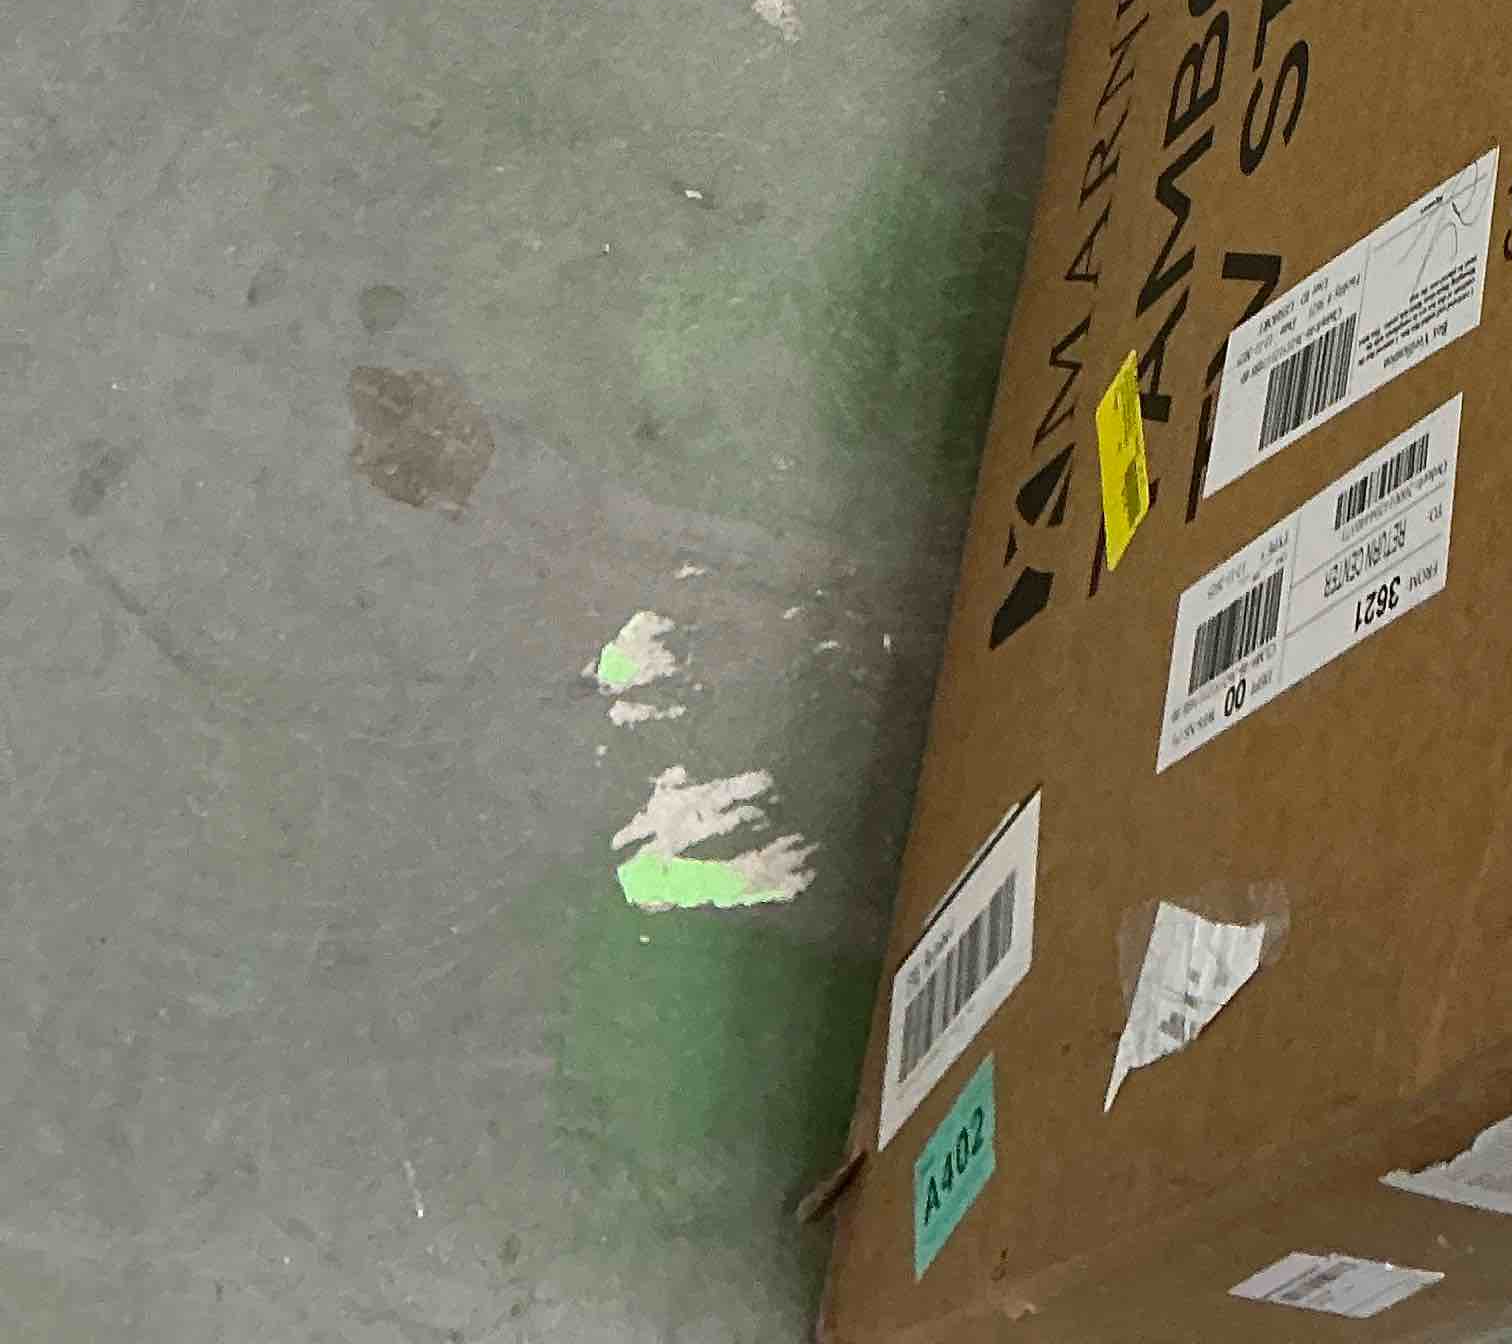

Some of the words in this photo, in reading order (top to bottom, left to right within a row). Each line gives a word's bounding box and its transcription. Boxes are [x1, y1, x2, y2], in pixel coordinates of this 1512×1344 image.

[1354, 575, 1401, 633] 3621
[1224, 678, 1247, 718] 00
[923, 1106, 985, 1227] A402
